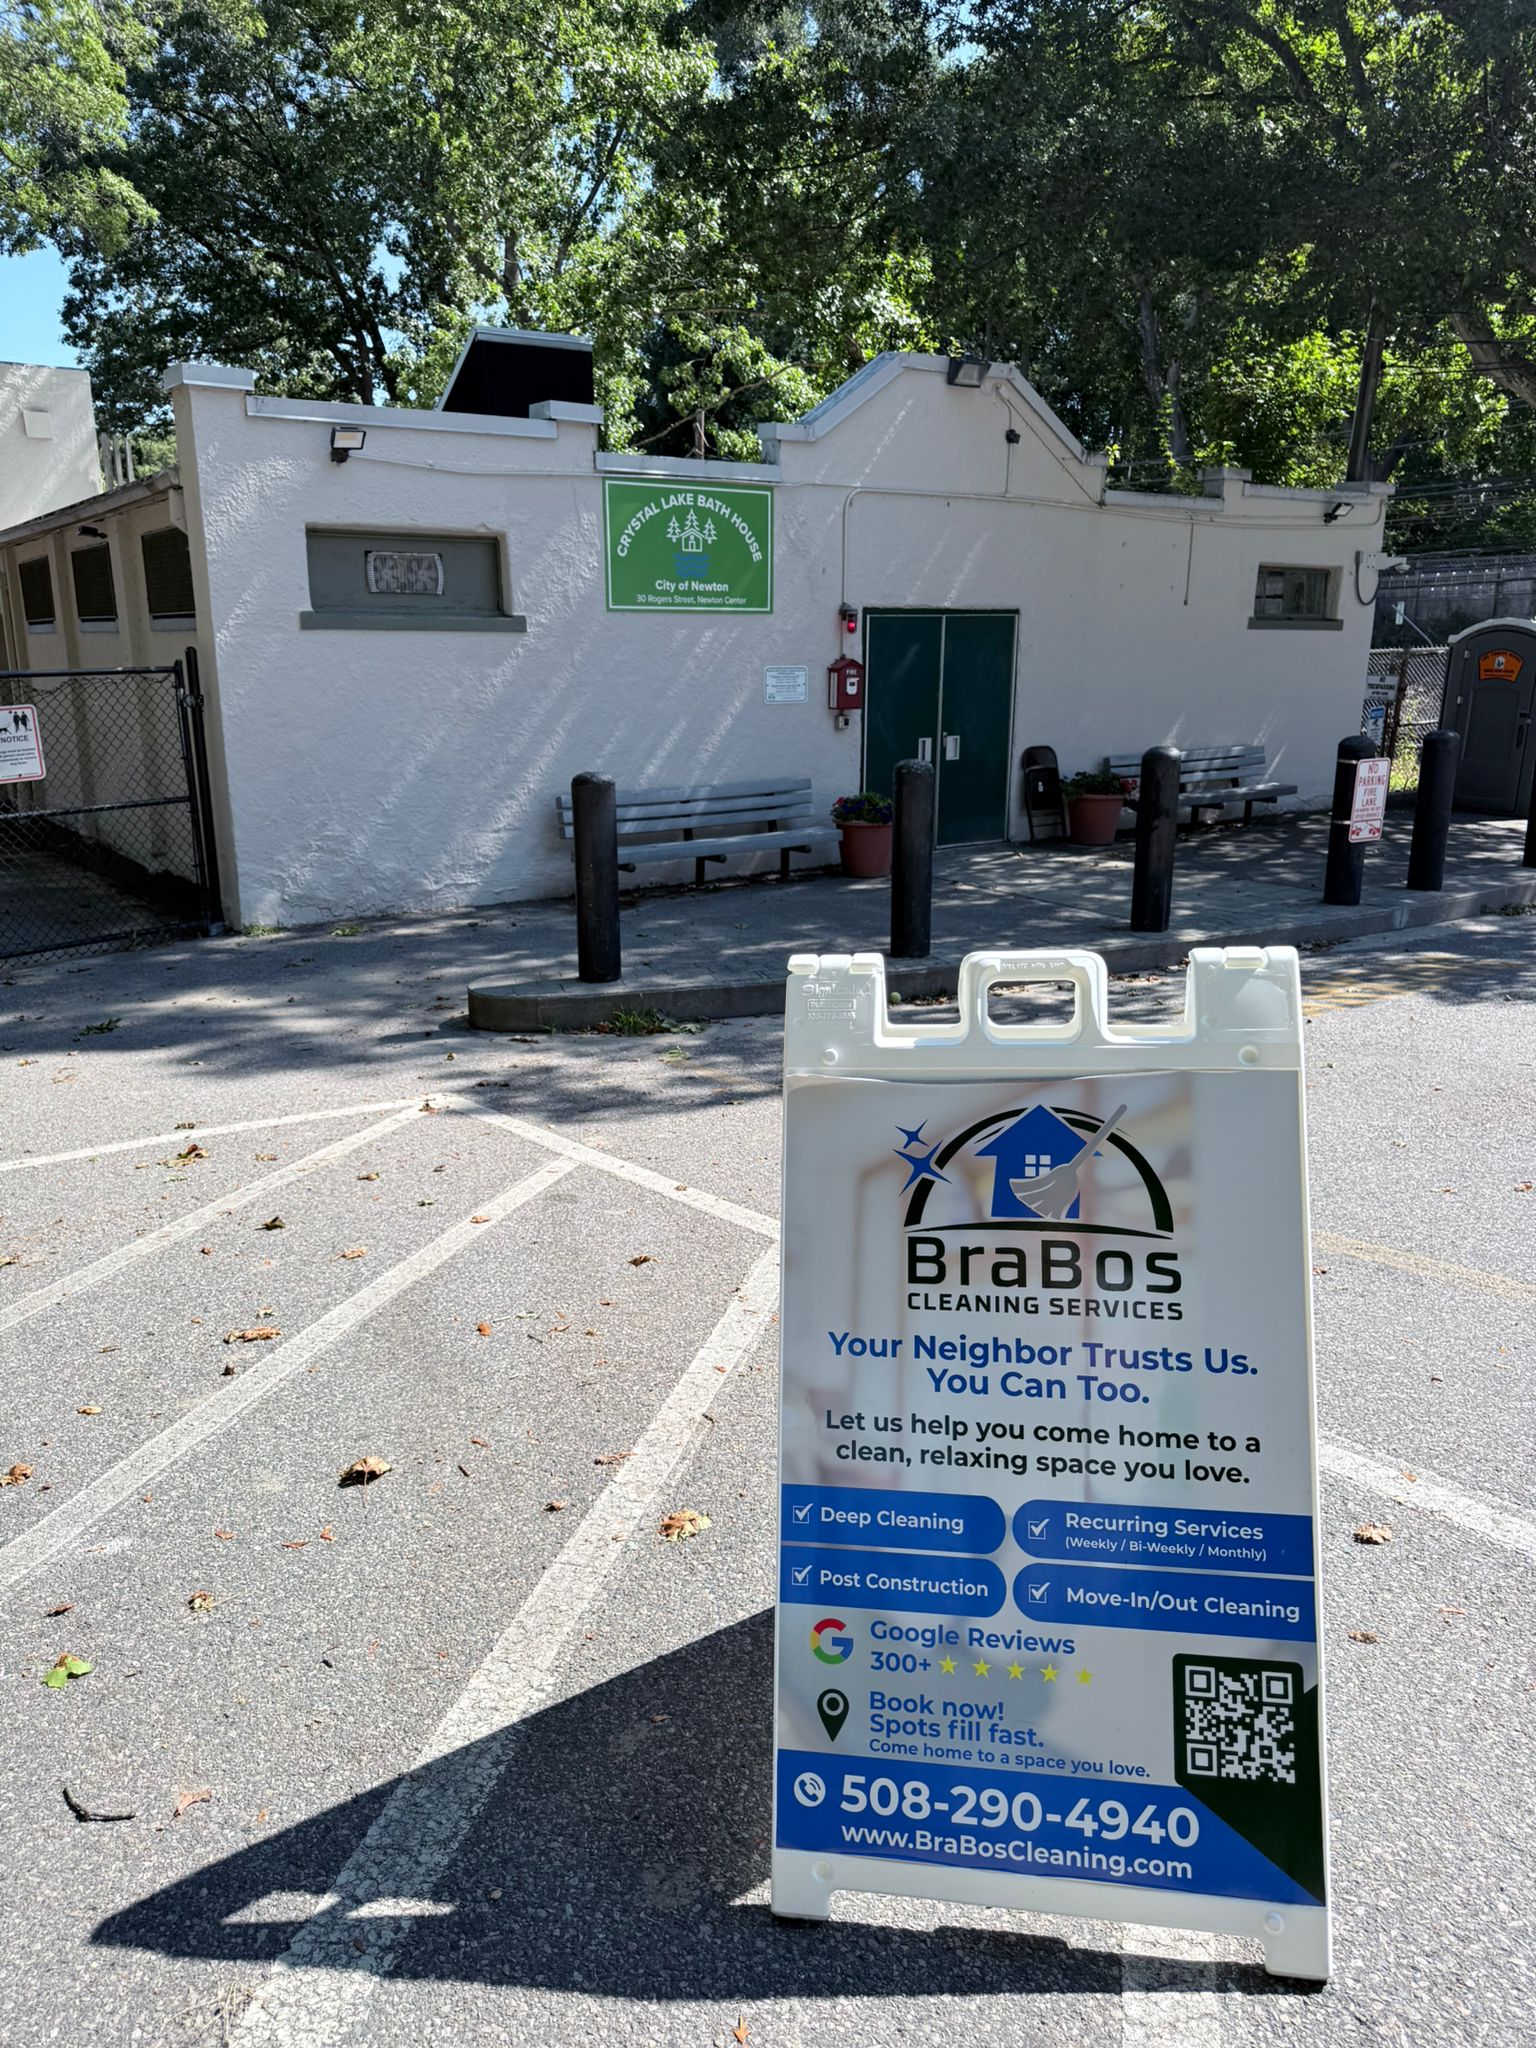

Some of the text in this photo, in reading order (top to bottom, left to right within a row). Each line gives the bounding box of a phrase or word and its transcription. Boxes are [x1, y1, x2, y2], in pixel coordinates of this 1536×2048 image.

[617, 493, 763, 562] CRYSTAL LAKE BATH HOUSE
[636, 594, 647, 603] 30
[647, 594, 672, 605] Rogers
[697, 595, 723, 604] Newton
[724, 596, 747, 604] Center
[655, 579, 729, 592] City of Newton
[0, 735, 29, 743] NOTICE
[1359, 775, 1386, 787] PARKING
[1368, 763, 1379, 774] NO
[1361, 797, 1377, 807] LANE
[1364, 787, 1377, 797] FIRE
[907, 1292, 1183, 1321] CLEANING SERVICES
[828, 1331, 1259, 1376] Your Neighbor Trusts Us.
[926, 1367, 1151, 1404] You Can Too.
[826, 1409, 1261, 1453] Let us help you come home to a
[835, 1440, 1250, 1484] clean, relaxing space you love.
[820, 1507, 964, 1535] Deep Cleaning
[1065, 1512, 1264, 1540] Recurring Services
[1065, 1536, 1267, 1562] (Weekly / Bi-Weekly / Monthly)
[820, 1569, 989, 1597] Post Construction
[1067, 1587, 1300, 1624] Move-In/Out Cleaning
[870, 1620, 1076, 1654] Google Reviews
[870, 1651, 932, 1674] 300+
[869, 1690, 1005, 1721] Book now!
[869, 1714, 1045, 1748] Spots fill fast.
[869, 1739, 1151, 1778] Come home to a space you love.
[840, 1775, 1200, 1847] 508-290-4940
[841, 1823, 1194, 1880] www.BraBosCleaning.com
